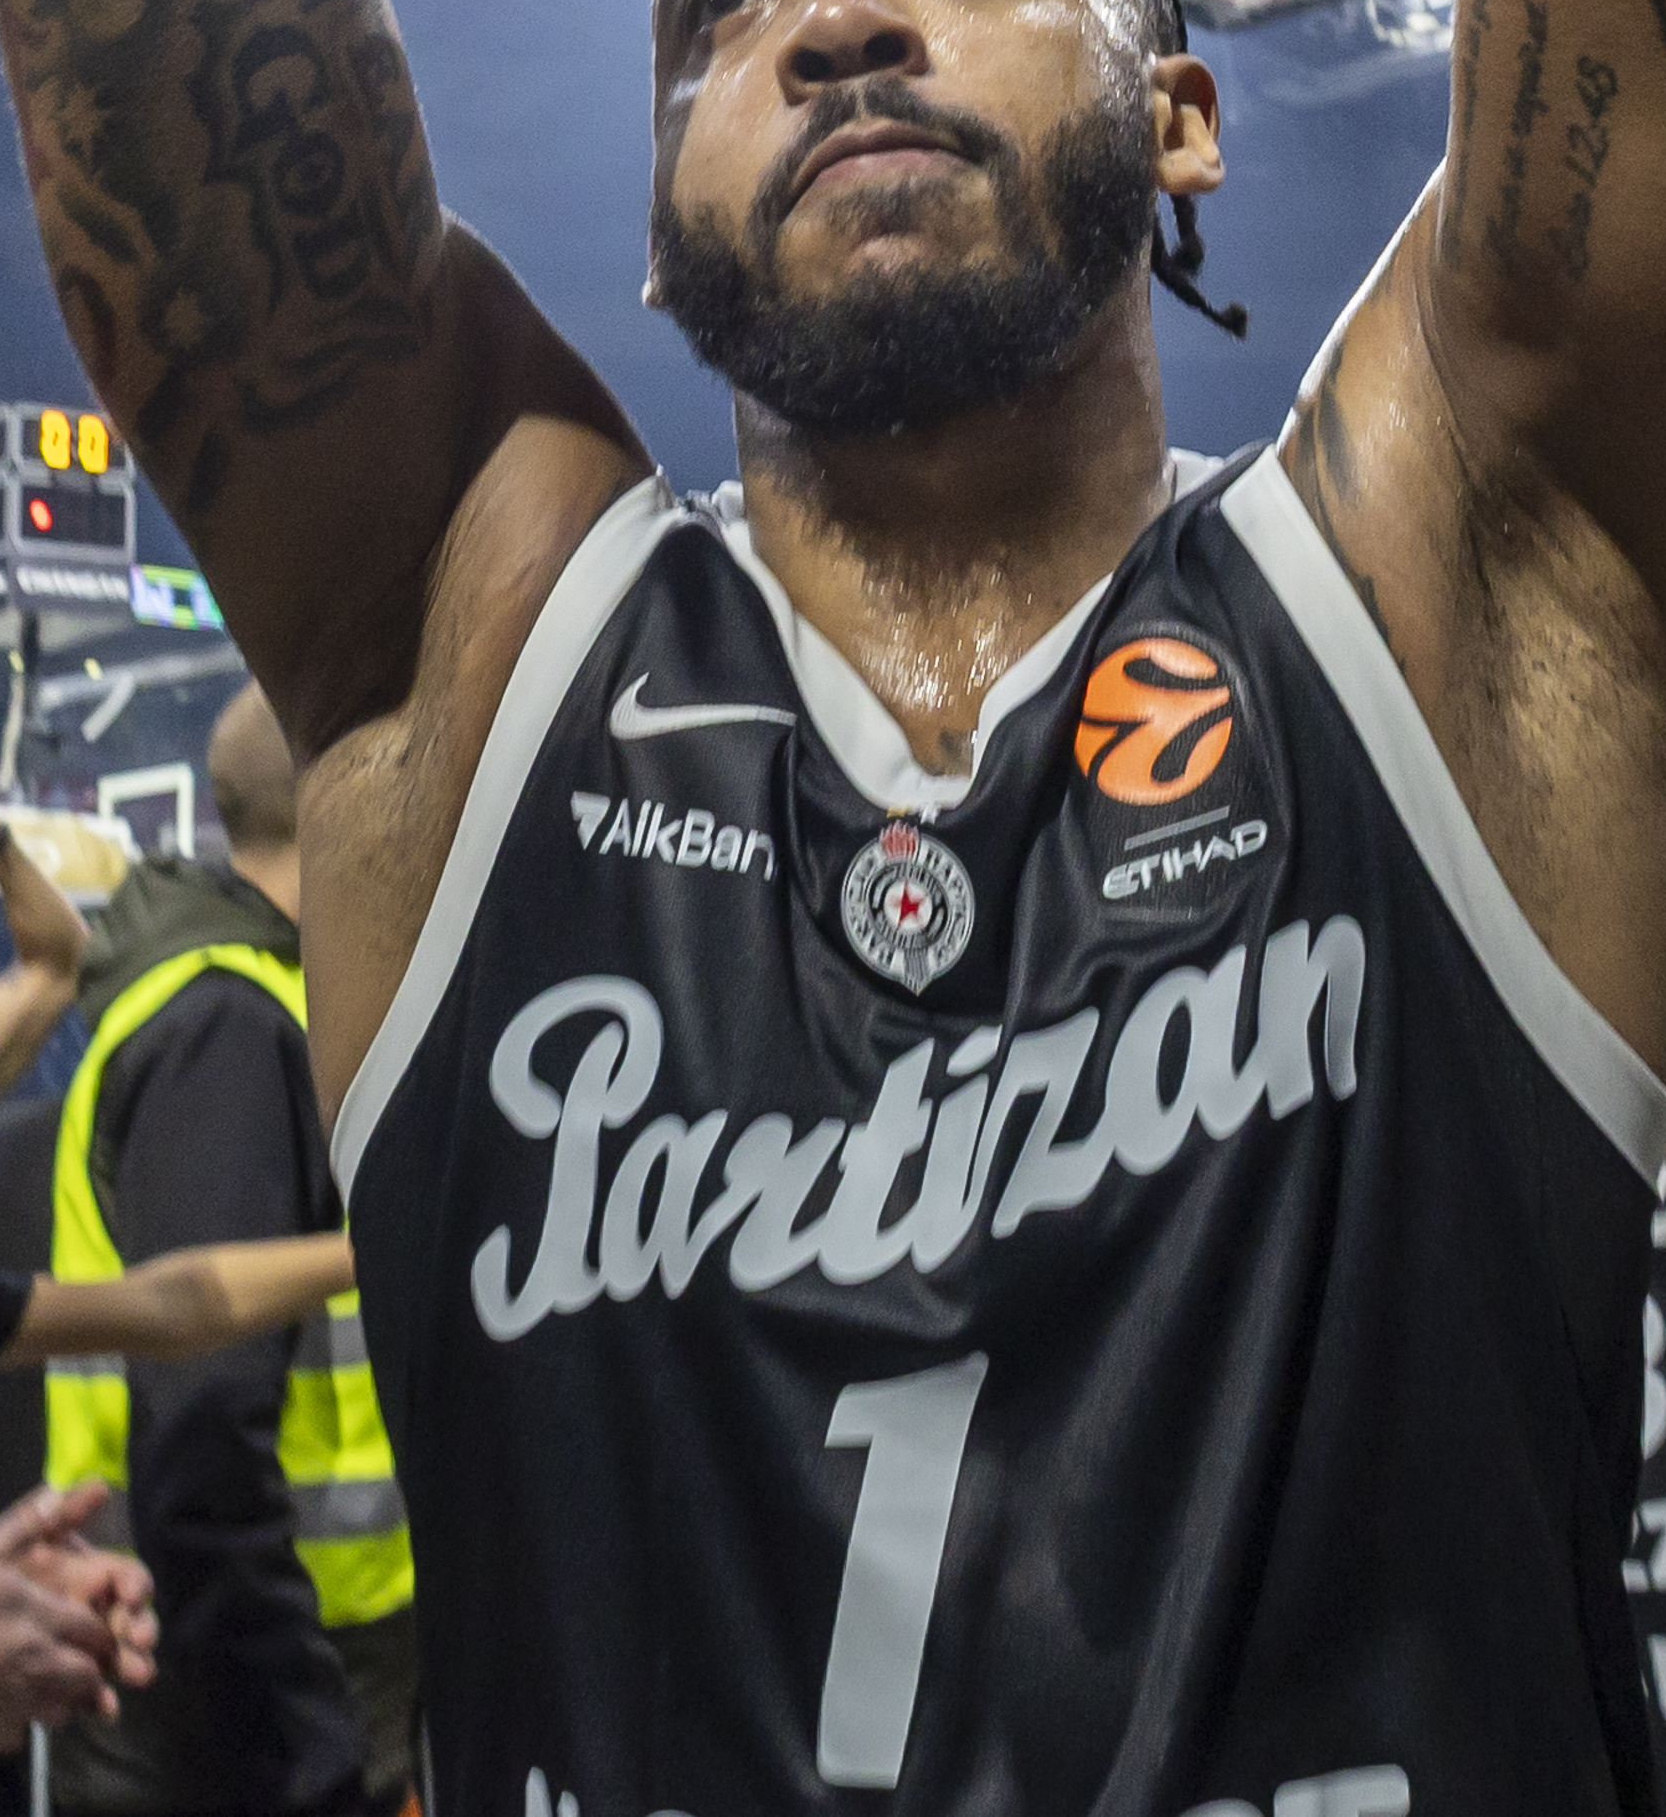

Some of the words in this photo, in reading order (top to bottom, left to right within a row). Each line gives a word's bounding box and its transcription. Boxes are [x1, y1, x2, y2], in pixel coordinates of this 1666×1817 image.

[1102, 819, 1268, 900] ETIHAD
[470, 913, 1366, 1342] Partizan
[815, 1350, 989, 1790] 1
